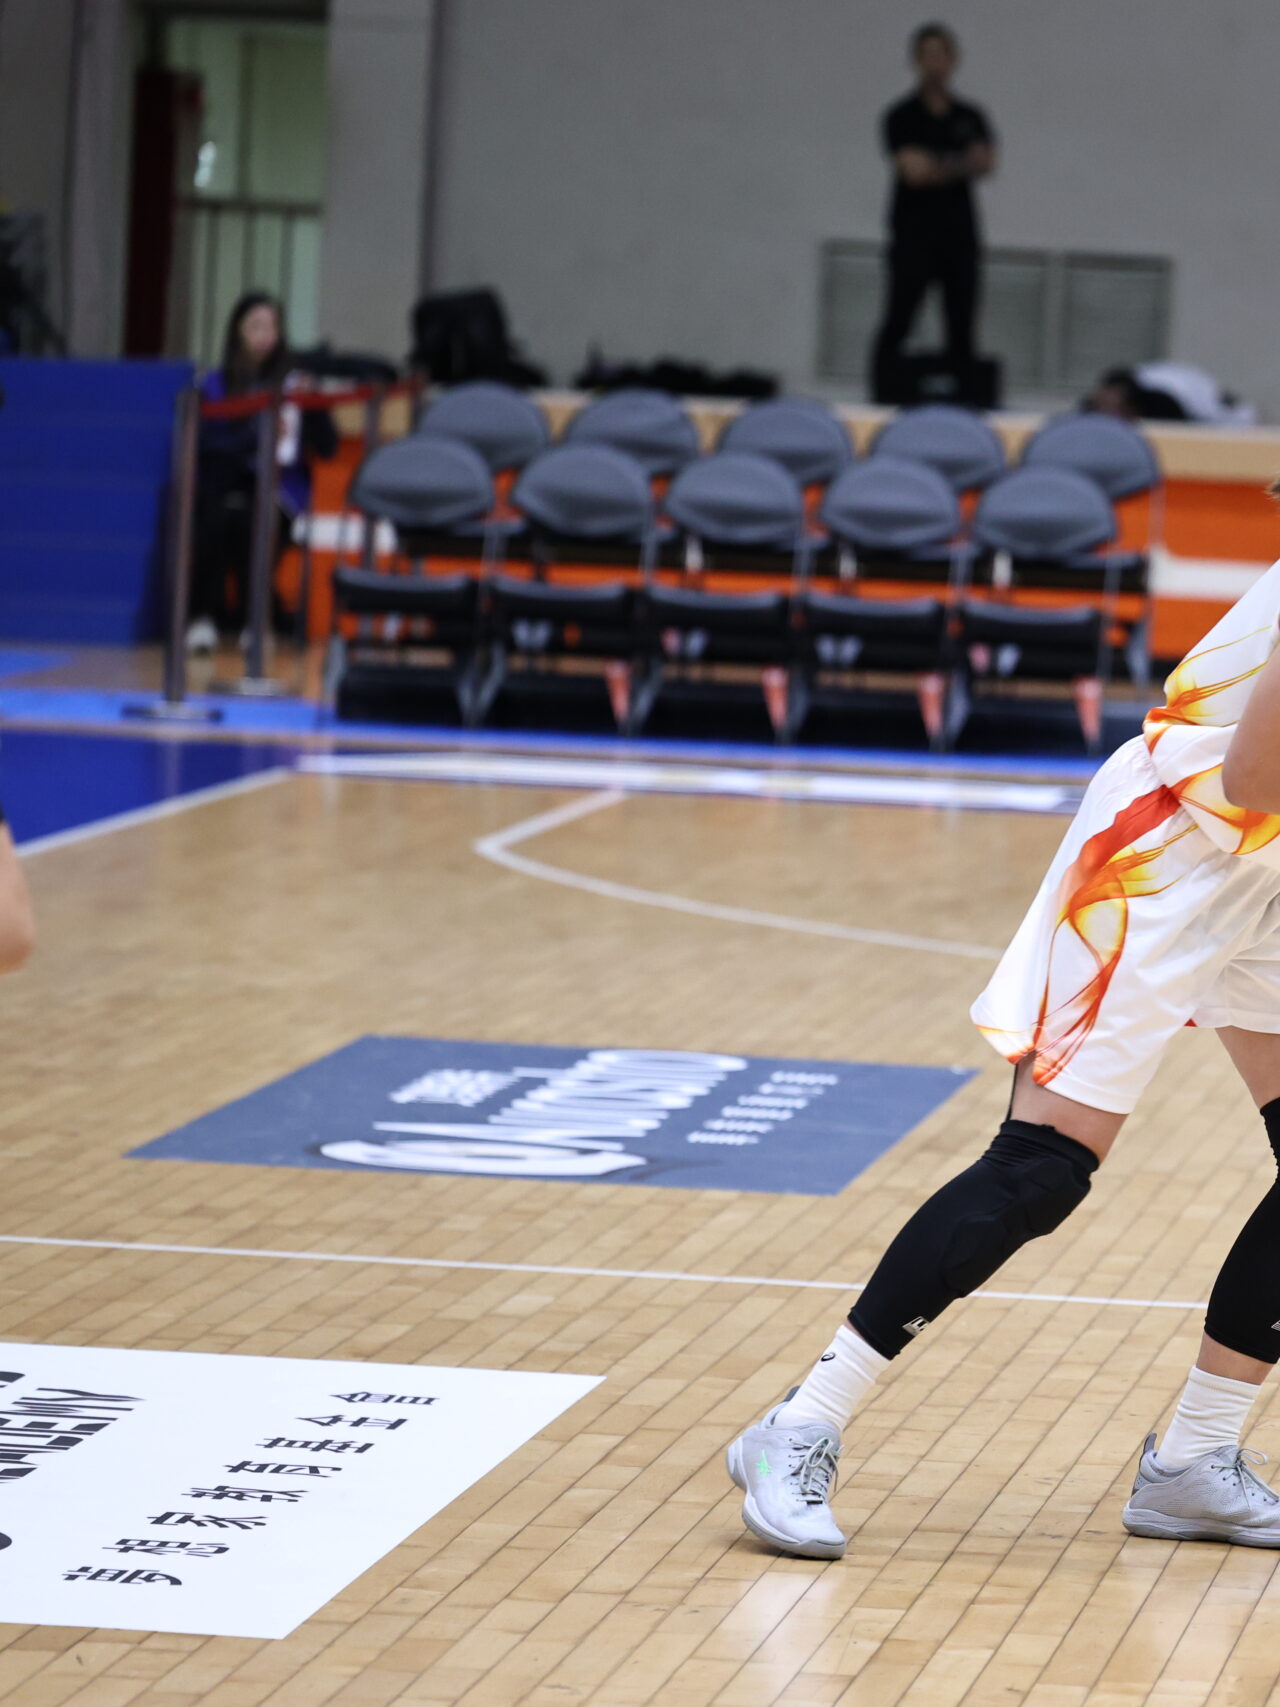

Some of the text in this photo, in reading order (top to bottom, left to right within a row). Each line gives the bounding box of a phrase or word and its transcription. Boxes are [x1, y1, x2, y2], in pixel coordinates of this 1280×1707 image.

[61, 1391, 440, 1586] 夢想家教育基金會
